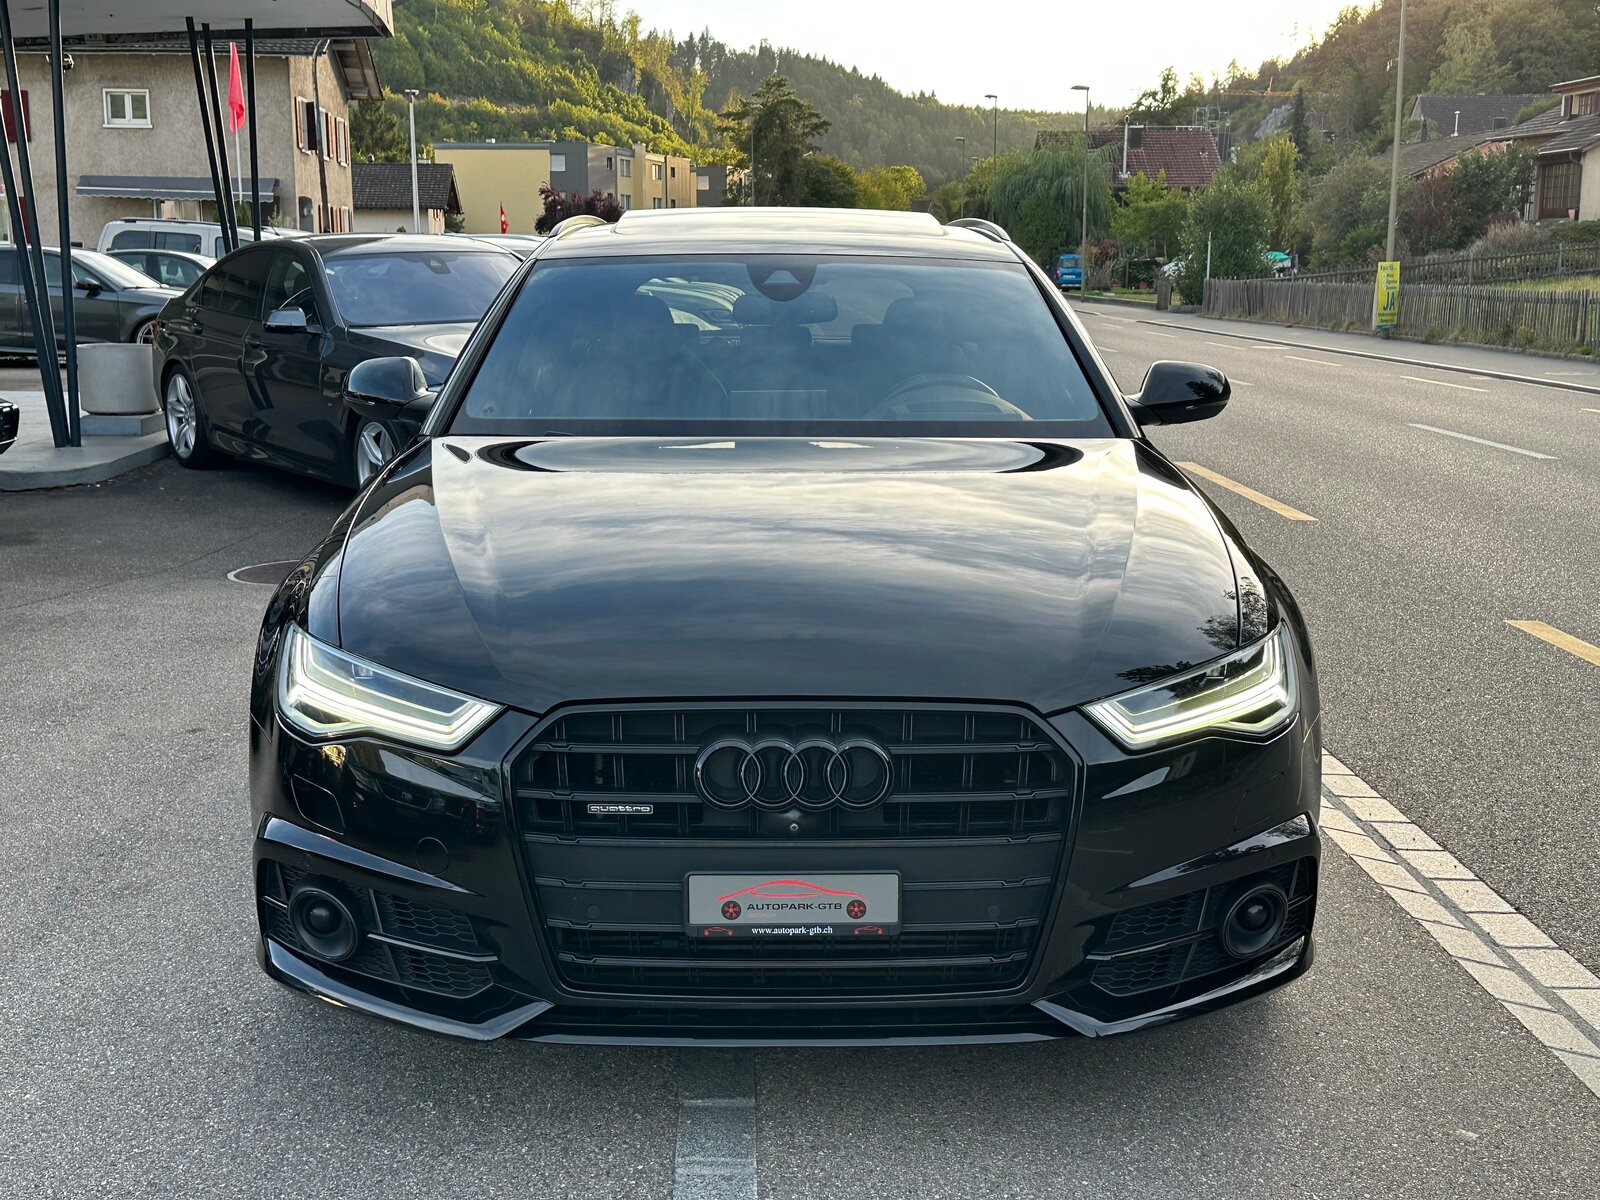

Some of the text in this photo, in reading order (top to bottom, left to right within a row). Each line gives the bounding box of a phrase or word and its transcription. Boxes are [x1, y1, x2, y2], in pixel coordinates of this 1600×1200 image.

[1383, 291, 1395, 310] JA
[589, 805, 651, 813] quattro
[751, 926, 833, 935] www.autopark-gtb.ch
